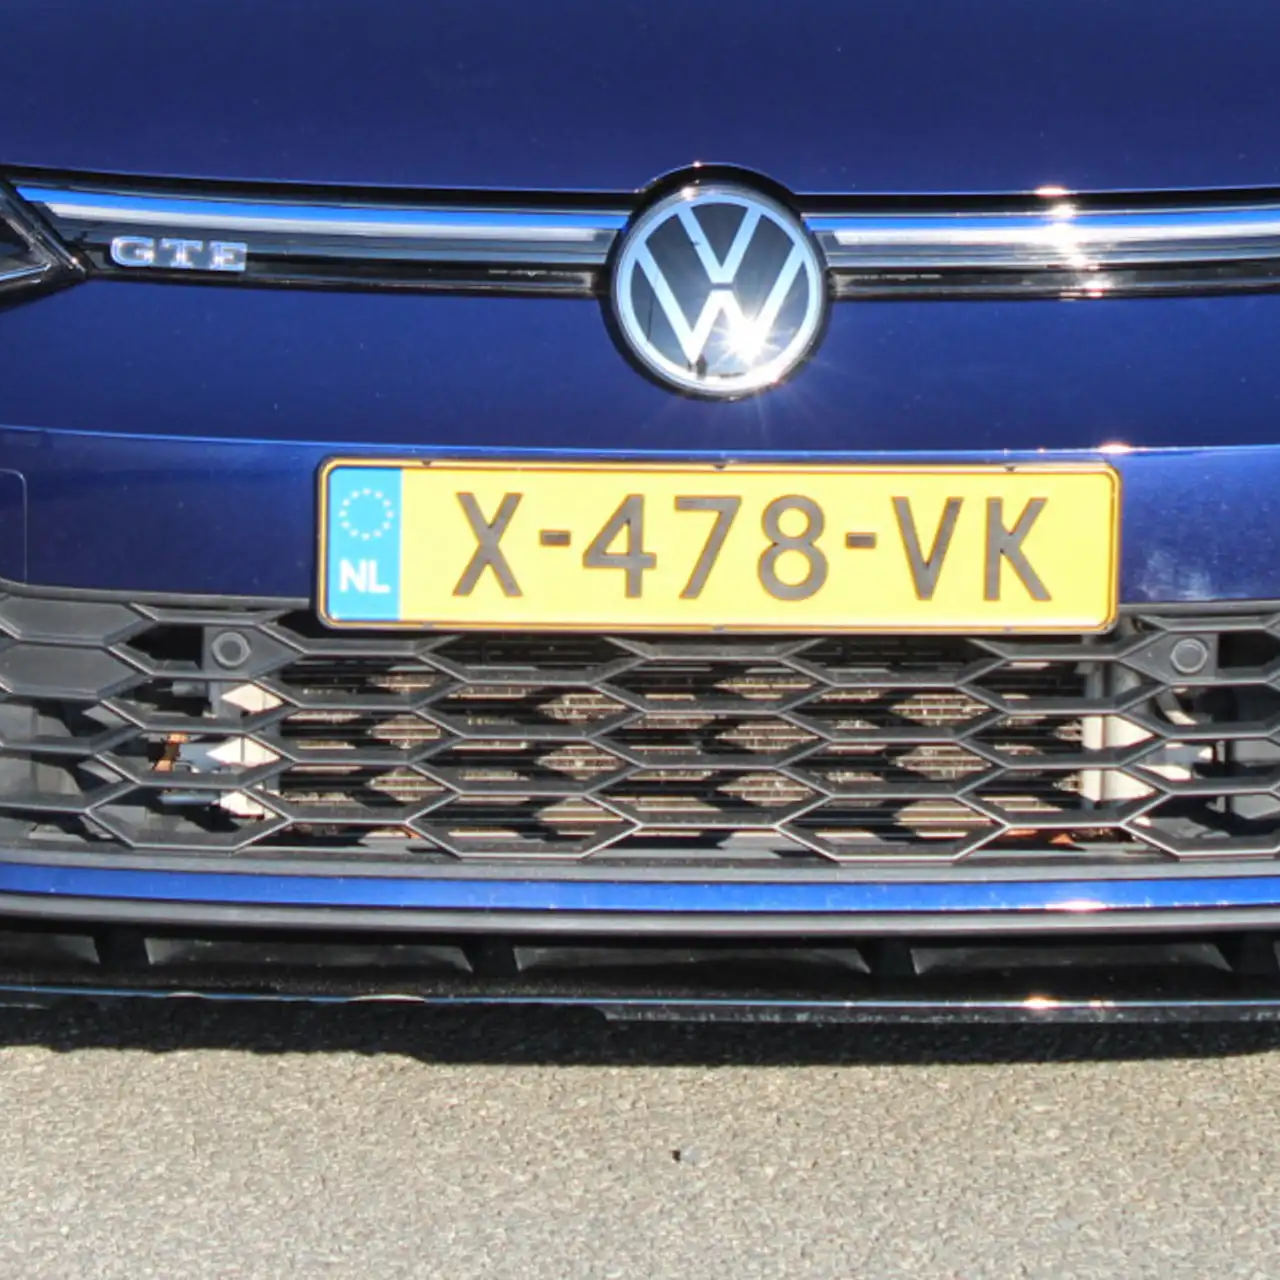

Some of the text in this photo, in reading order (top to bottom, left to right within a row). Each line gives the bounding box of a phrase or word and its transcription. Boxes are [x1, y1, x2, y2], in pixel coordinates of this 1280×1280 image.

[110, 235, 248, 271] GTE
[623, 193, 817, 384] VW
[339, 558, 390, 593] NL
[451, 491, 1053, 602] X-478-VK
